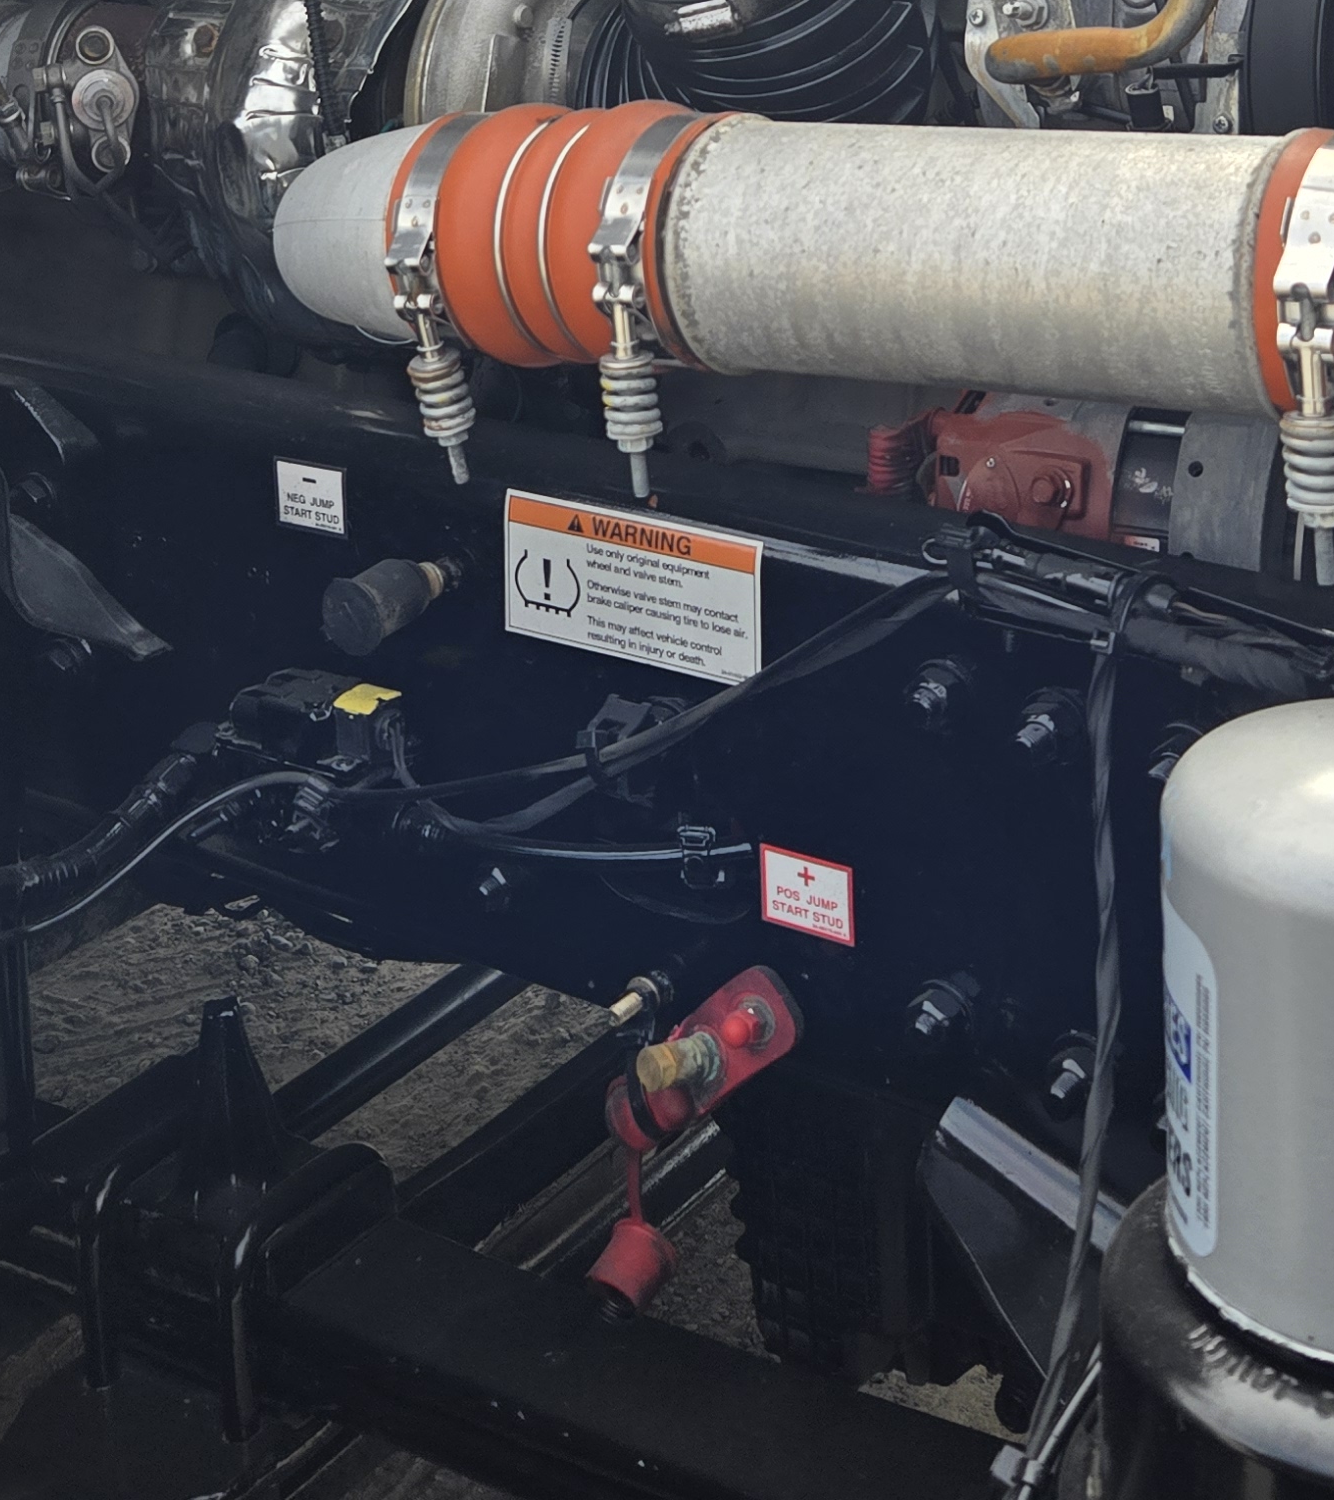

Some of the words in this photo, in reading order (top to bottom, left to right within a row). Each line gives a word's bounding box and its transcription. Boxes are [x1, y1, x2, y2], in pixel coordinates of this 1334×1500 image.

[283, 505, 312, 519] START
[315, 511, 340, 525] STUD
[287, 492, 306, 504] NEG
[310, 497, 334, 510] JUMP
[592, 515, 692, 556] WARNING
[586, 543, 604, 555] Use
[605, 547, 625, 563] only
[627, 551, 660, 570] original
[662, 560, 710, 581] equipment
[586, 560, 612, 573] wheel
[613, 564, 631, 576] and
[633, 569, 657, 582] valve
[658, 575, 683, 589] stem.
[587, 579, 631, 599] Otherwise
[633, 589, 657, 602] valve
[658, 596, 682, 609] stem
[683, 603, 703, 617] may
[704, 605, 739, 623] contact
[587, 593, 612, 607] brake
[613, 598, 643, 616] caliper
[645, 607, 681, 626] causing
[683, 613, 698, 627] tire
[700, 618, 710, 629] to
[712, 619, 731, 635] lose
[733, 626, 748, 639] air.
[587, 615, 606, 630] This
[607, 621, 627, 635] may
[629, 623, 654, 640] affect
[656, 631, 688, 649] vehicle
[690, 639, 722, 656] control
[587, 631, 626, 649] resulting
[628, 639, 637, 650] in
[639, 641, 664, 658] injury
[666, 649, 676, 658] or
[678, 652, 706, 667] death.
[772, 900, 809, 919] START
[812, 912, 843, 929] STUD
[777, 886, 800, 902] POS
[806, 895, 838, 911] JUMP
